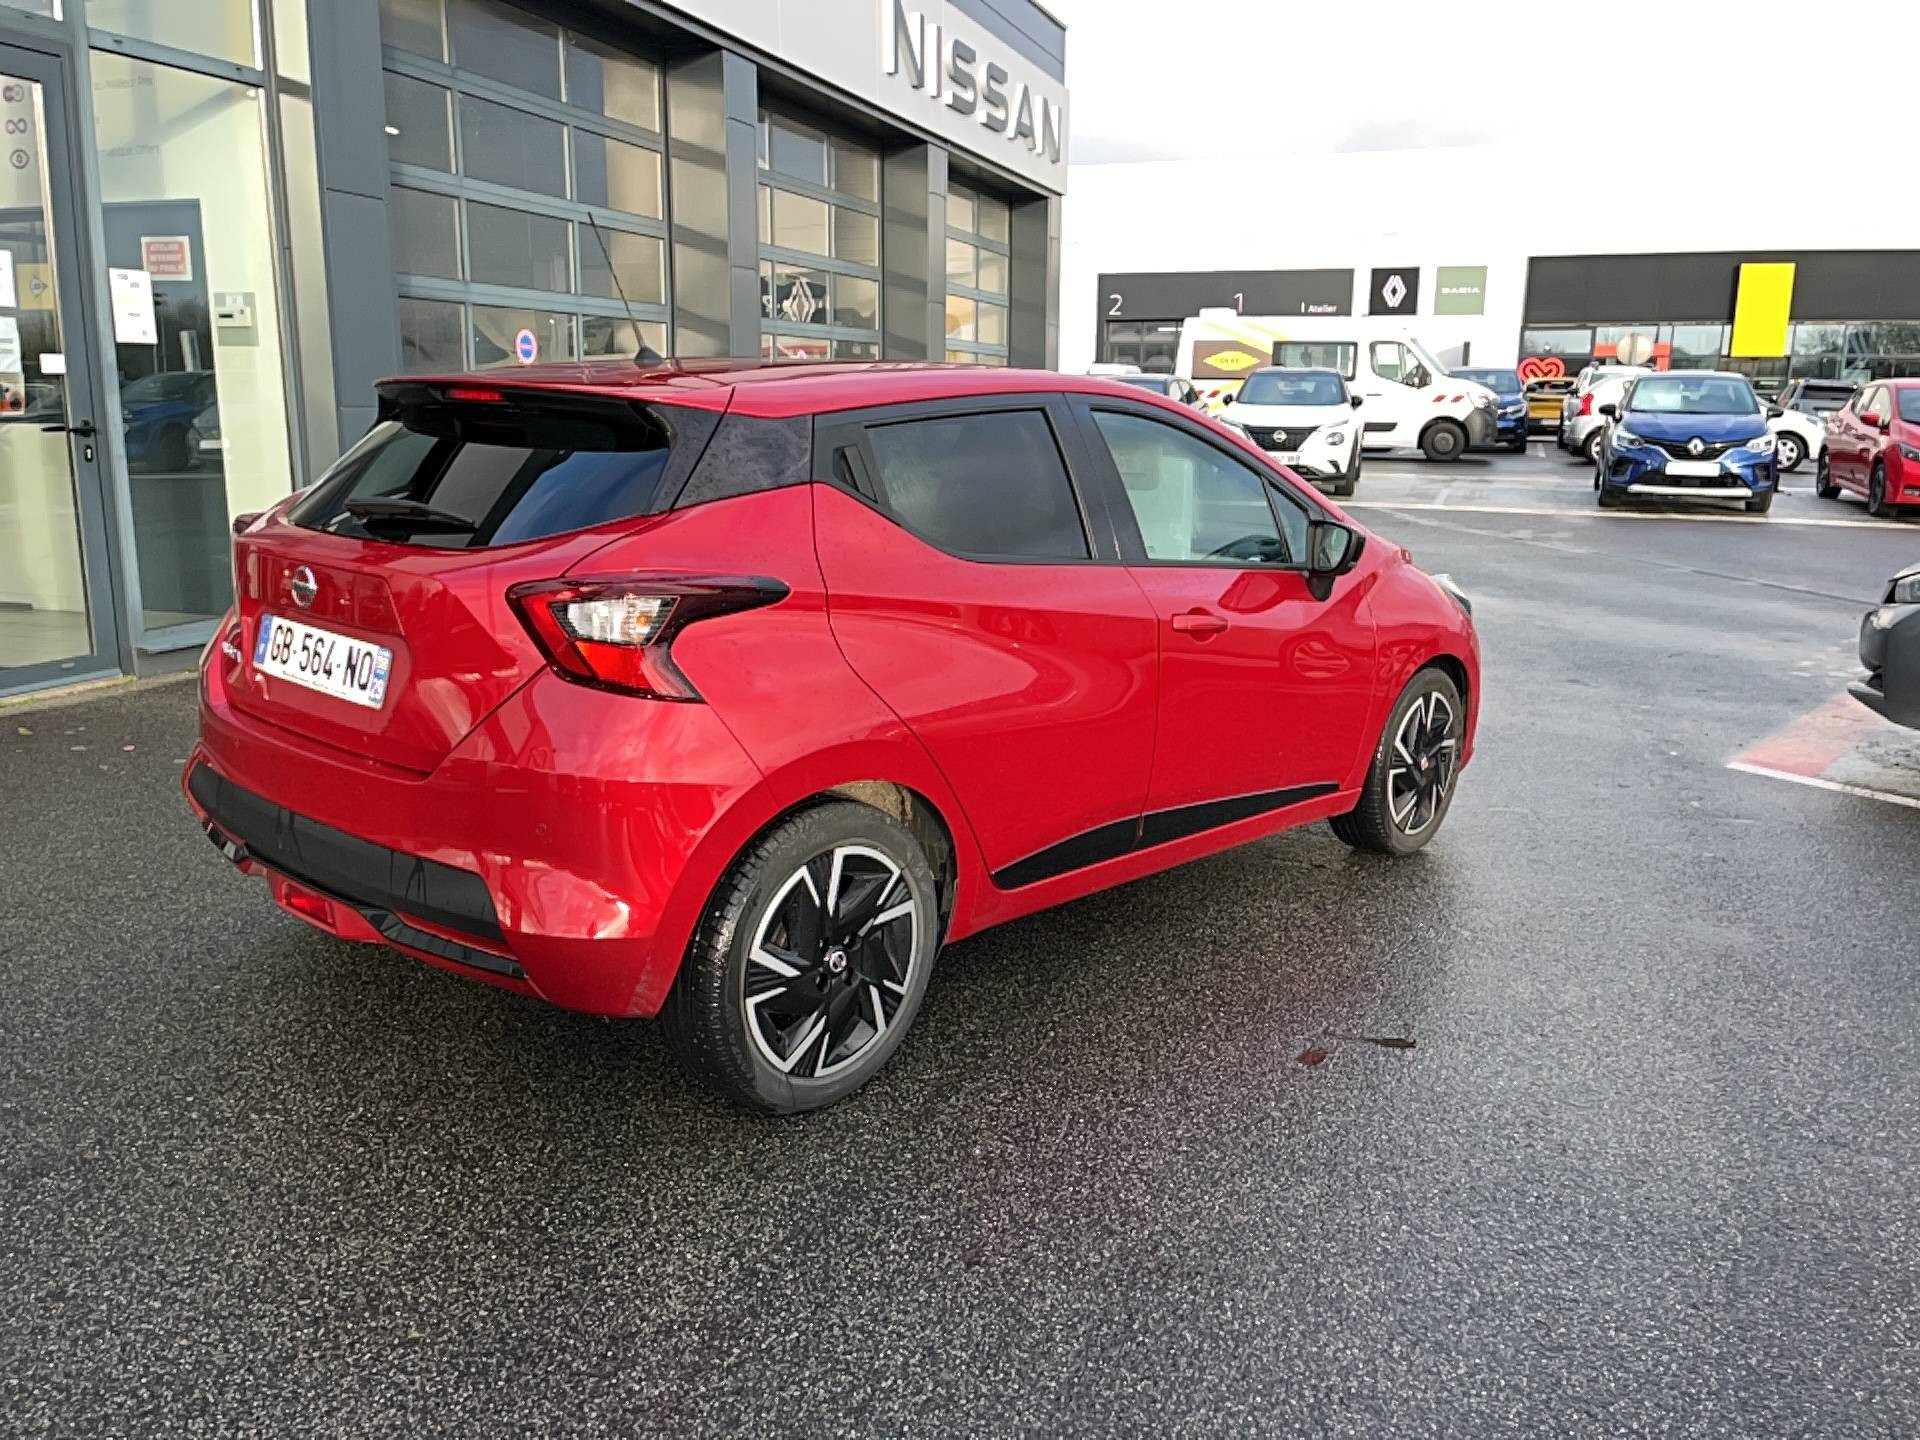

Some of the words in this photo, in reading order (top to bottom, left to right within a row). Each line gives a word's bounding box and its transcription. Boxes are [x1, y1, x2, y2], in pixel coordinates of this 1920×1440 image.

[880, 0, 1062, 164] NISSAN
[1108, 294, 1123, 316] 2
[1233, 293, 1244, 314] 1
